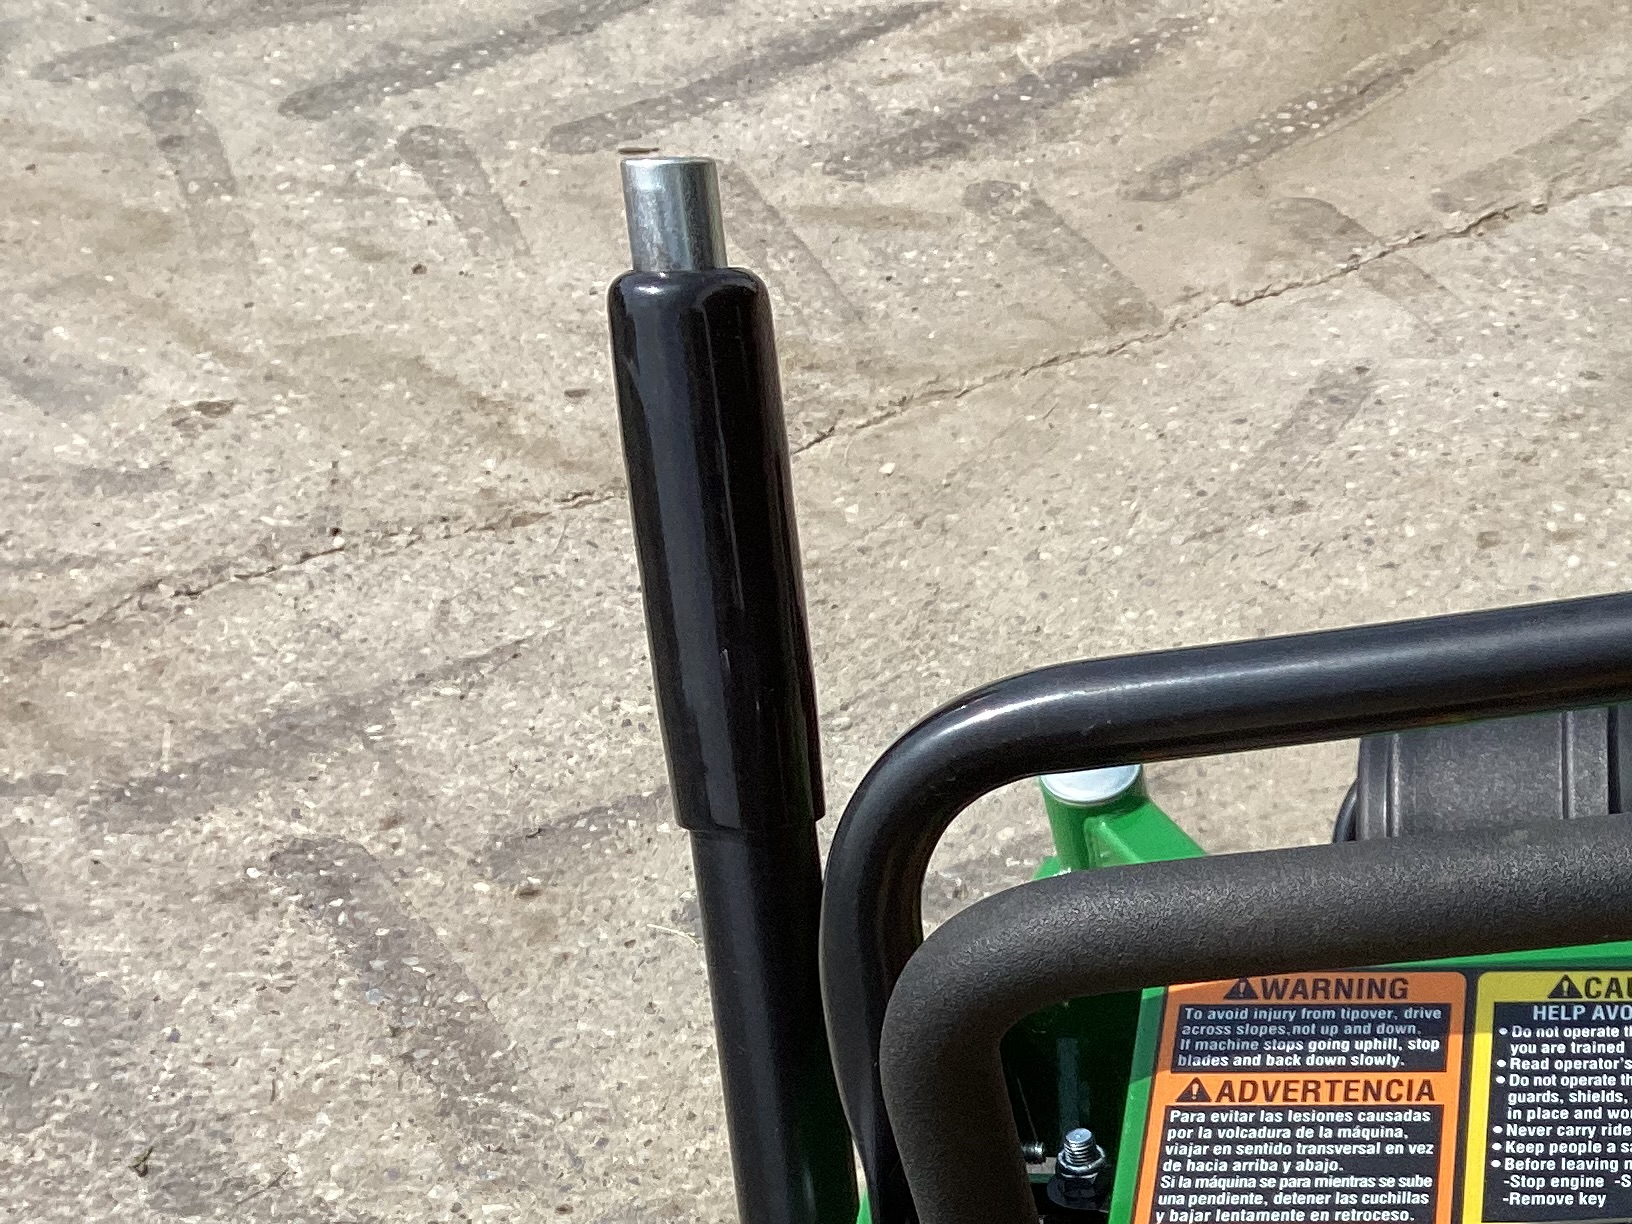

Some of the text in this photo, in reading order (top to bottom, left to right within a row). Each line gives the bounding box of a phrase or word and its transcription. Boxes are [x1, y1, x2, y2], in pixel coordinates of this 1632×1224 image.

[1259, 978, 1408, 1000] WARNING
[1534, 1005, 1585, 1020] HELP
[1178, 1054, 1404, 1068] blades and back down slowly.
[1510, 1058, 1549, 1070] Read
[1509, 1074, 1529, 1086] Do
[1534, 1074, 1556, 1086] not
[1561, 1074, 1616, 1088] operate
[1215, 1079, 1435, 1102] ADVERTENCIA
[1508, 1090, 1563, 1105] guards,
[1569, 1090, 1628, 1104] shields,
[1170, 1110, 1430, 1122] Para evitar las lesiones causadas
[1508, 1107, 1521, 1119] in
[1527, 1107, 1569, 1122] place
[1574, 1107, 1602, 1119] and
[1506, 1124, 1552, 1136] Never
[1557, 1126, 1596, 1138] carry
[1506, 1141, 1544, 1156] Keep
[1549, 1140, 1602, 1156] people
[1607, 1143, 1616, 1153] a
[1505, 1158, 1555, 1170] Before
[1562, 1157, 1618, 1172] leaving
[1504, 1175, 1545, 1190] -Stop
[1551, 1175, 1604, 1190] engine
[1158, 1191, 1429, 1207] una pendiente, detener las cuchillas
[1503, 1192, 1606, 1208] -Remove key
[1156, 1209, 1414, 1224] y bajar lentamente en retroceso.
